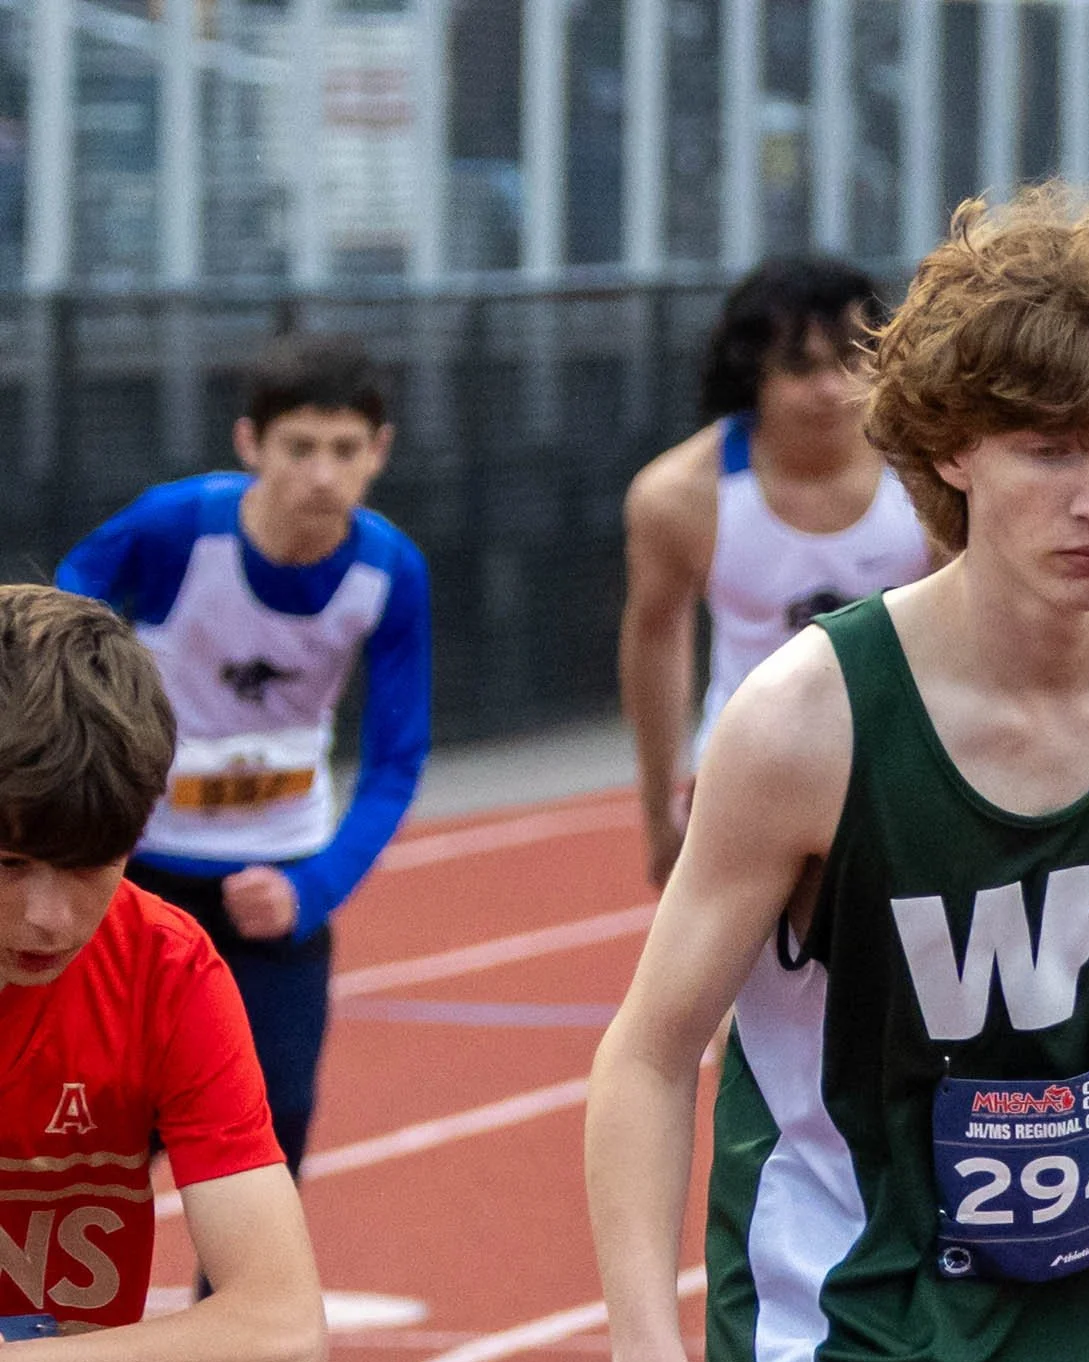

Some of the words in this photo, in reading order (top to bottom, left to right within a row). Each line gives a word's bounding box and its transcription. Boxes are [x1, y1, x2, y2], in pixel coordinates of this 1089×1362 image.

[45, 1083, 98, 1134] A
[965, 1122, 1012, 1140] JH/MS
[1015, 1118, 1082, 1139] REGIONAL
